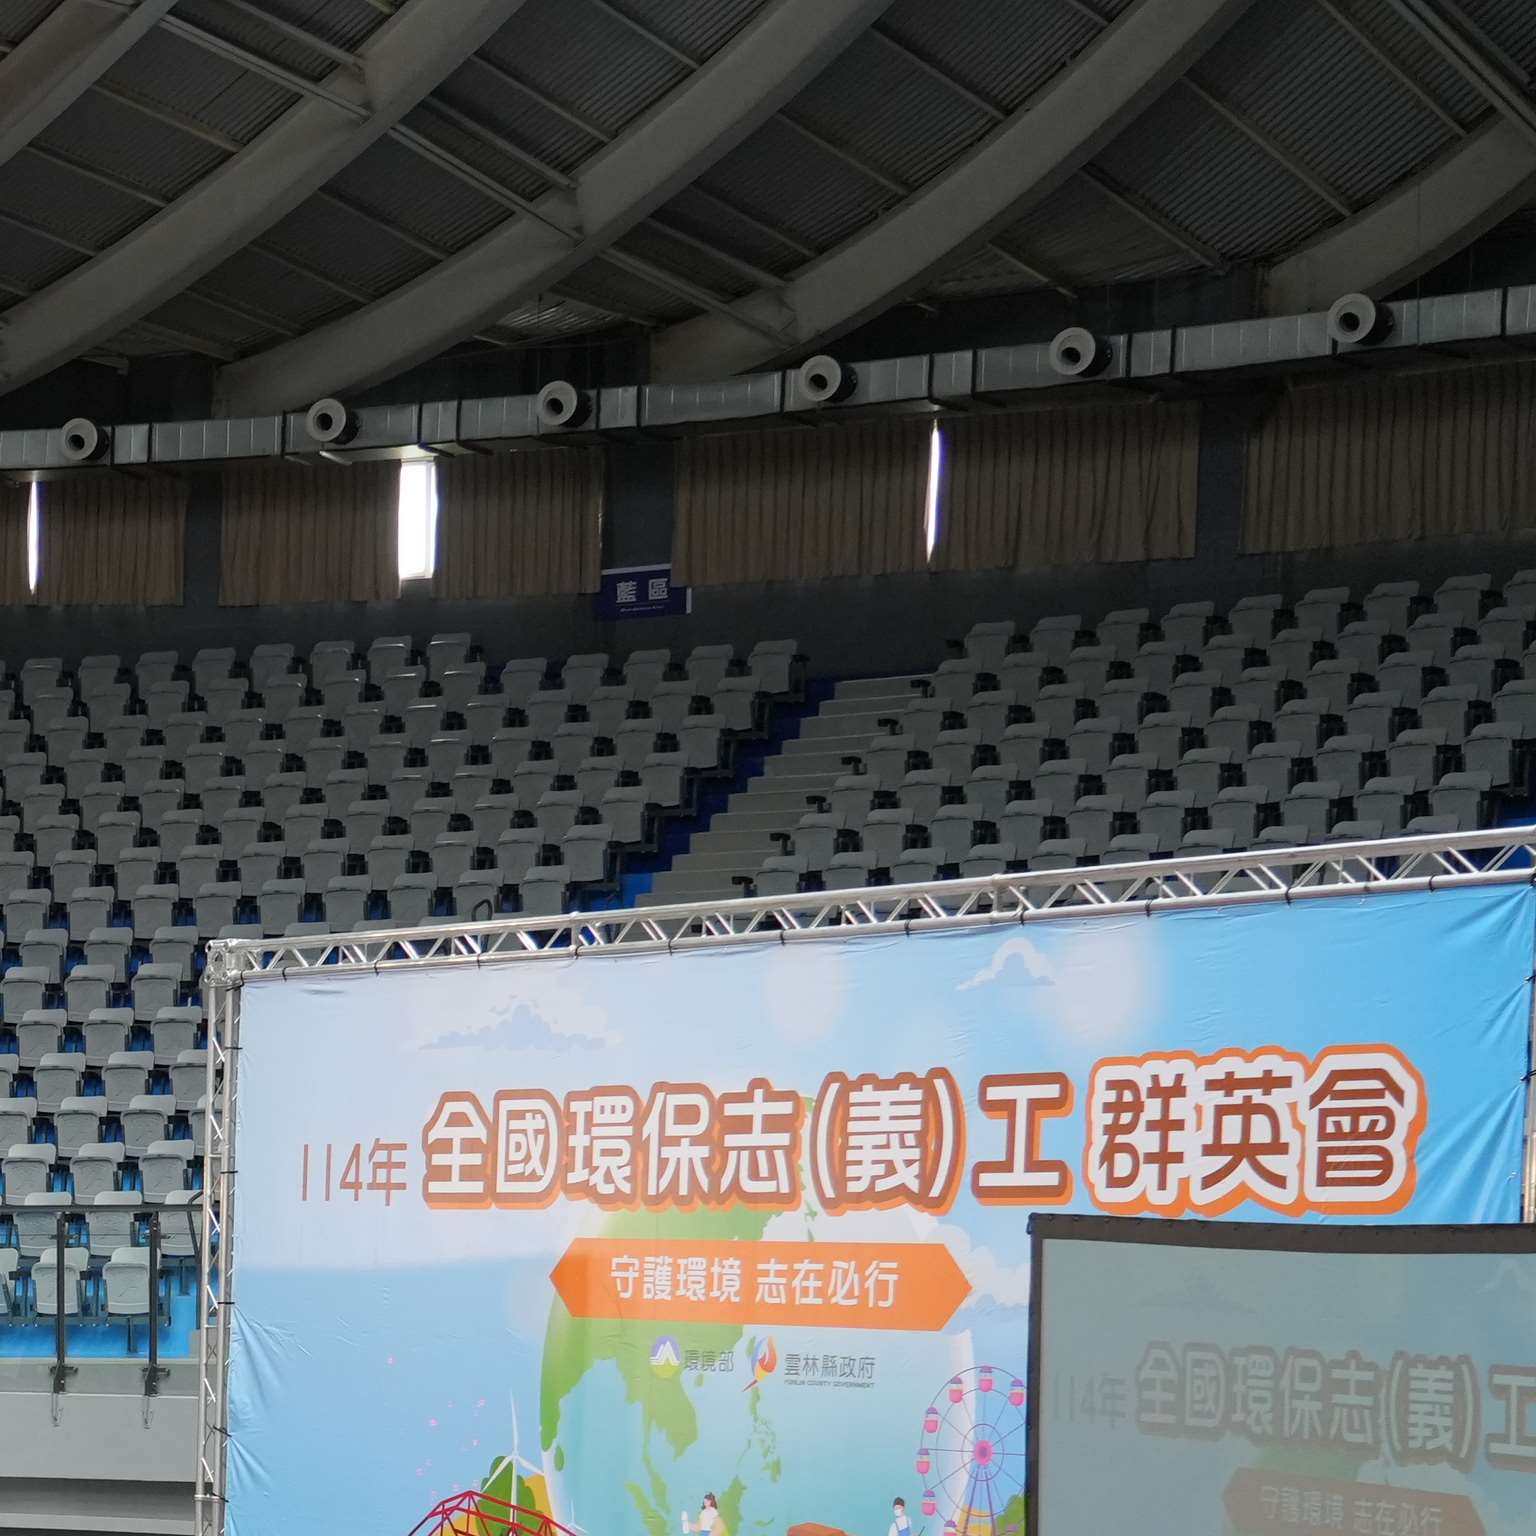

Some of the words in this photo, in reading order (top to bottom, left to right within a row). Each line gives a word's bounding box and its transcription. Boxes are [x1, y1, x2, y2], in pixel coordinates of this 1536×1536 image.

[301, 1137, 408, 1207] 114年
[610, 1254, 742, 1303] 守護環境
[755, 1257, 900, 1308] 志在必行
[684, 1348, 736, 1373] 環境部
[784, 1353, 876, 1380] 雲林縣政府
